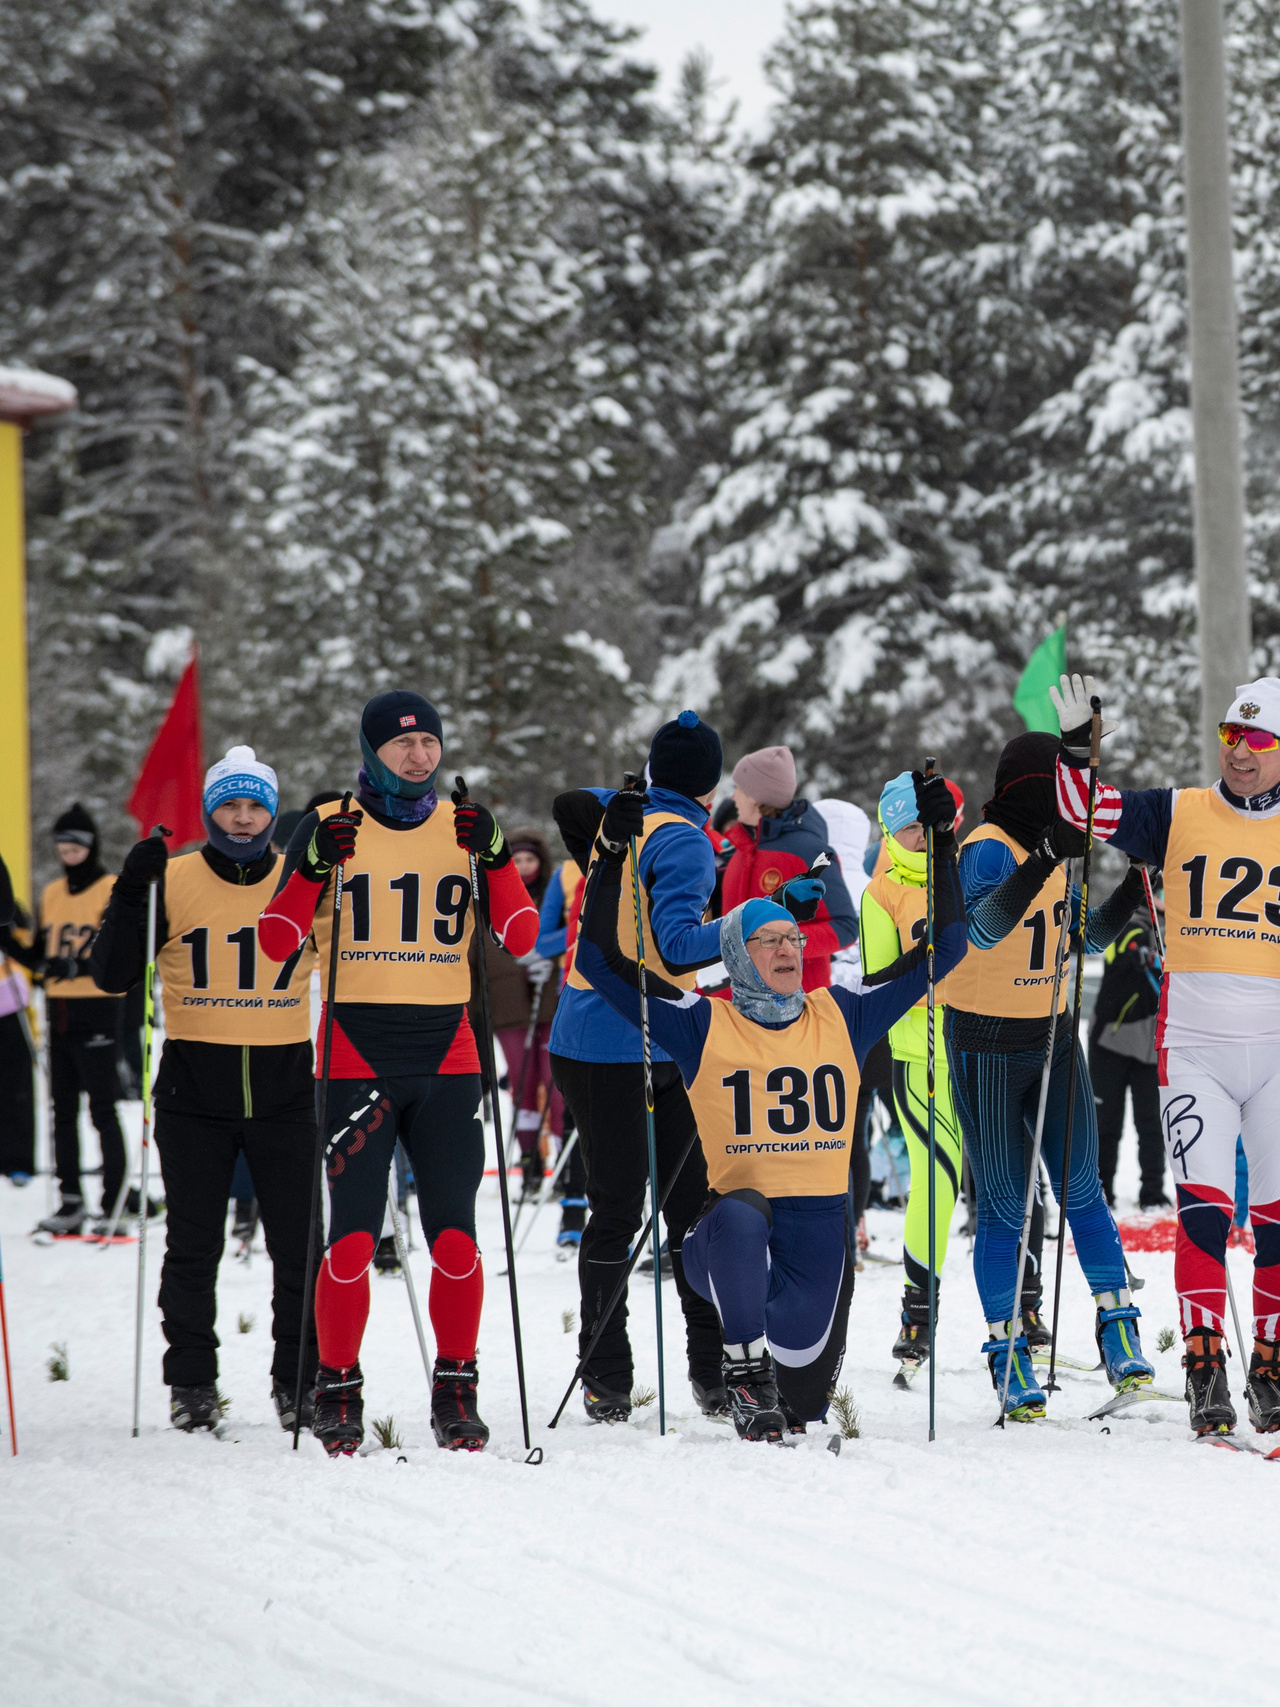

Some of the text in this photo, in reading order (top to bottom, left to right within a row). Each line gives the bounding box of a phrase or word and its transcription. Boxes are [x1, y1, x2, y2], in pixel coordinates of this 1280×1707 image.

[335, 864, 344, 911] MADSHUS
[470, 853, 480, 901] MADSHUS
[342, 872, 472, 947] 119
[1180, 926, 1256, 940] СУРГУТСКИЙ
[180, 926, 310, 991] 117
[340, 950, 461, 964] СУРГУТСКИЙ РАЙОН
[182, 996, 300, 1008] СУРГУТСКИЙ РАЙОН
[641, 994, 653, 1092] SWIX
[721, 1062, 846, 1137] 130
[725, 1138, 847, 1154] СУРГУТСКИЙ РАЙОН
[326, 1378, 363, 1389] MADSHUS
[436, 1370, 475, 1378] MADSHUS
